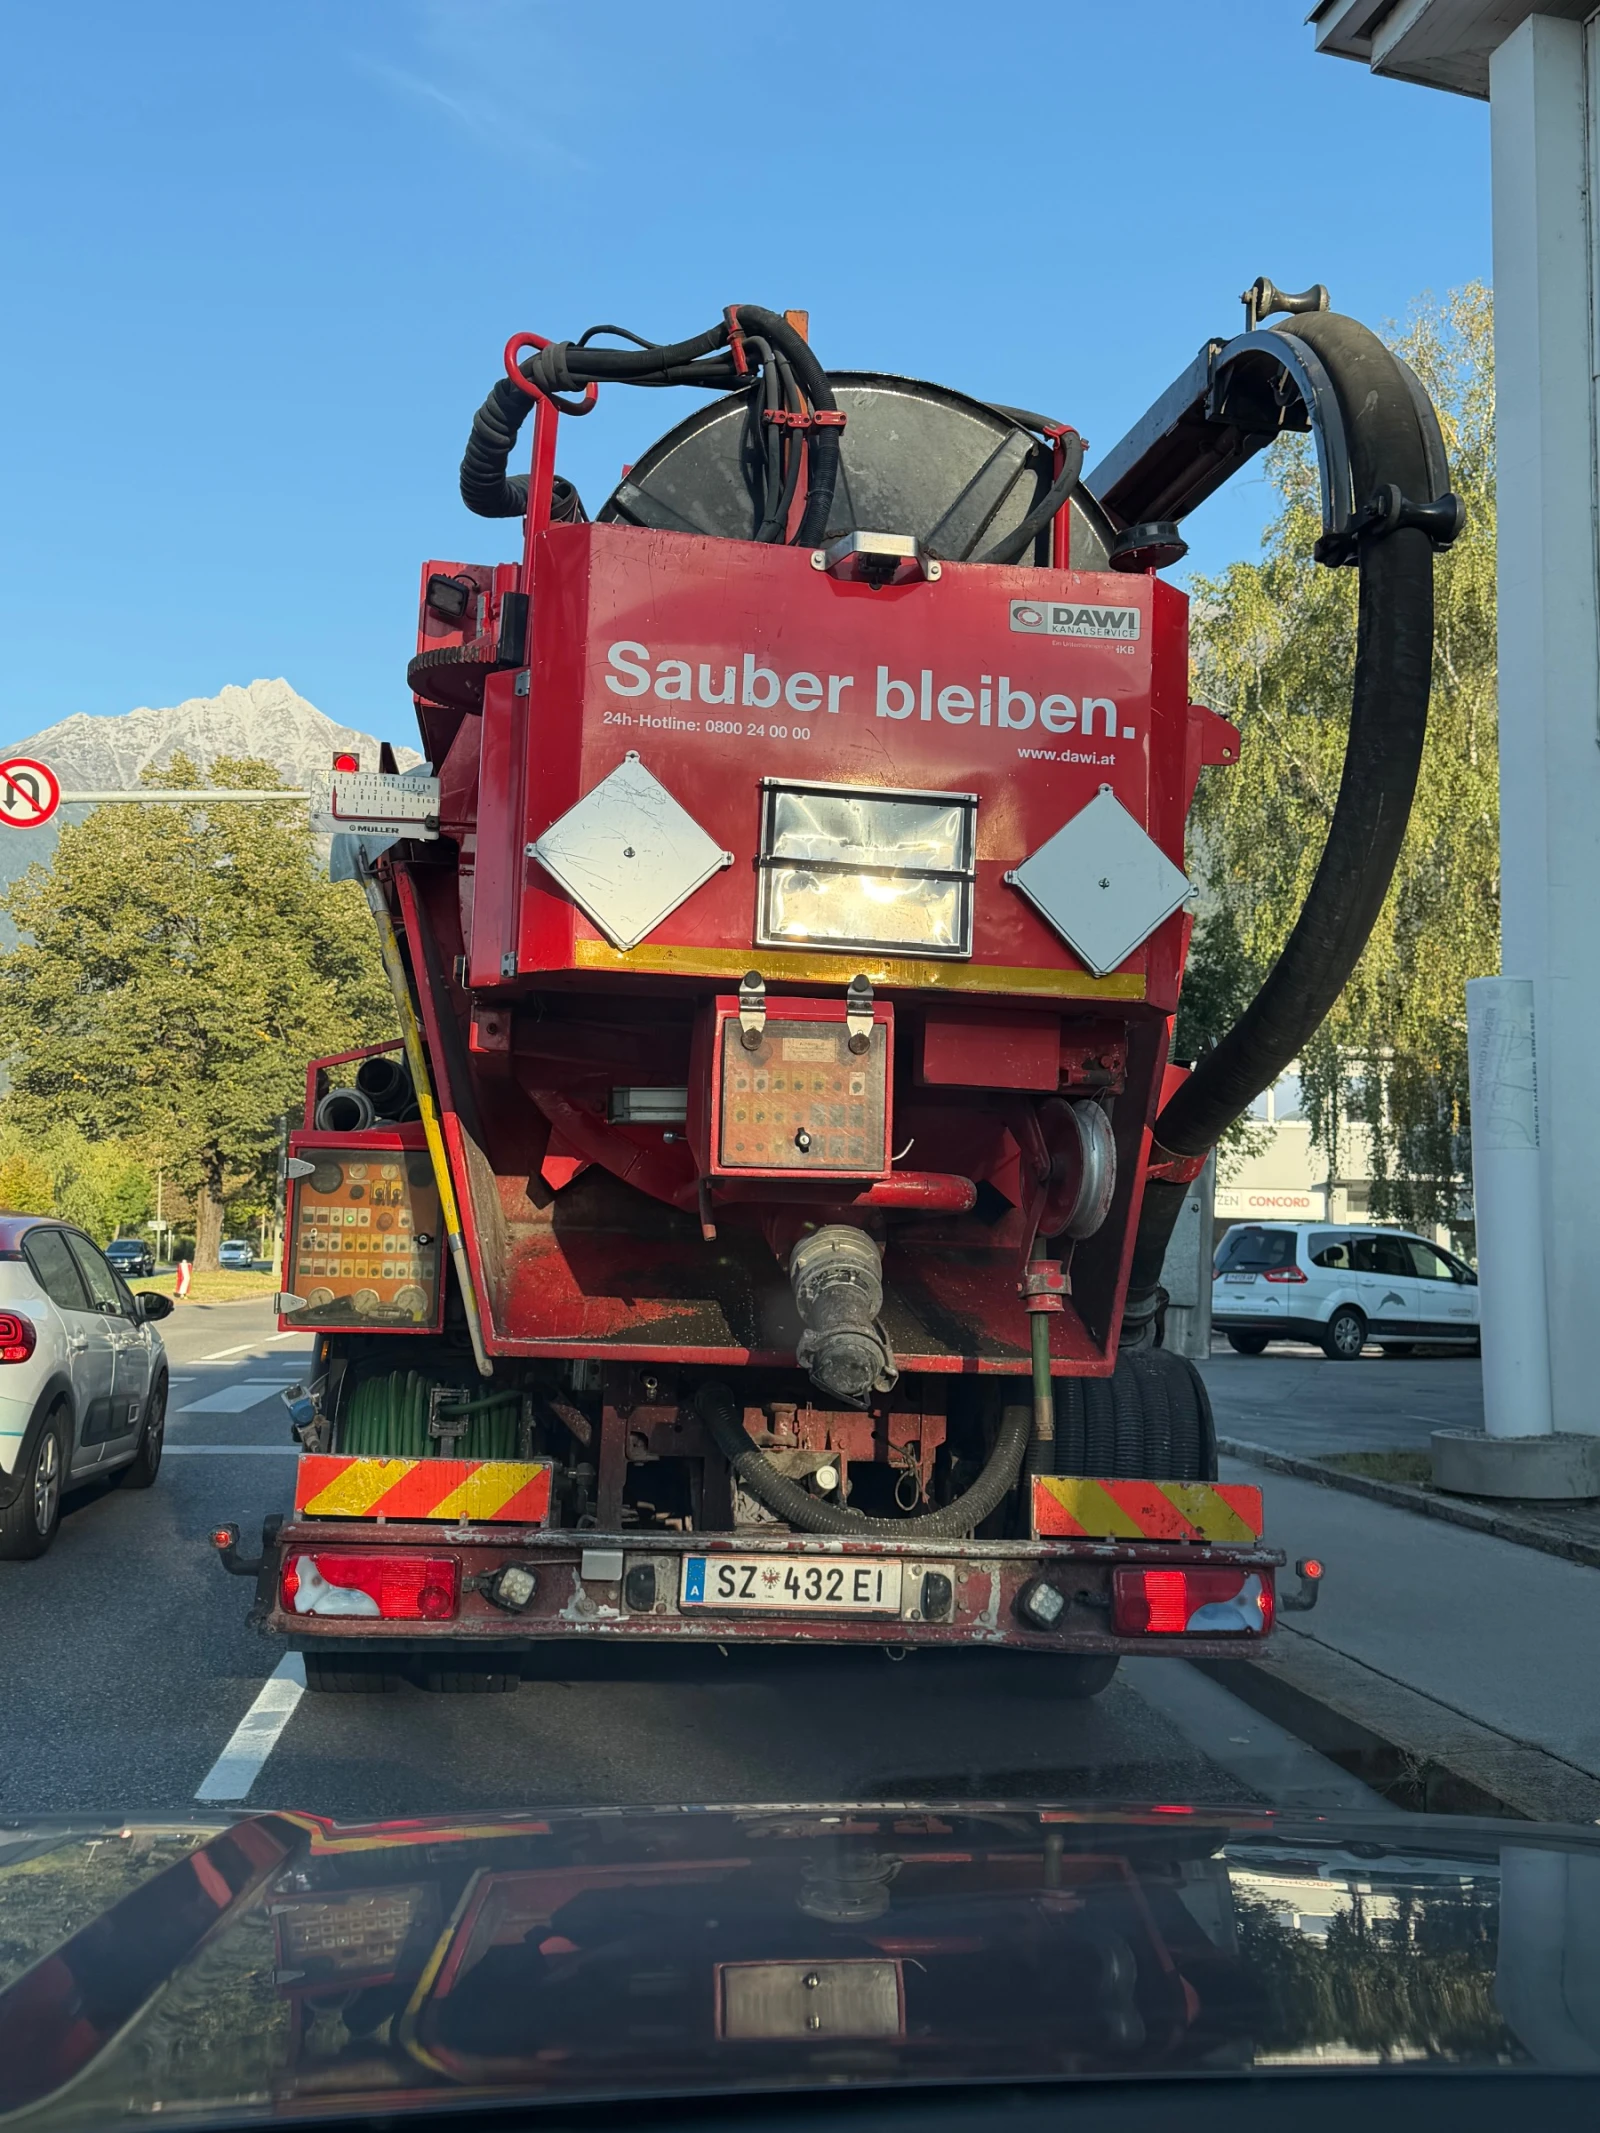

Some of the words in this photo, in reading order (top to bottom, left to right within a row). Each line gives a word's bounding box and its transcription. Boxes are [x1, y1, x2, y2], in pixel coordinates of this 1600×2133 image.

[1053, 607, 1135, 629] DAWI
[1052, 625, 1135, 638] KANALSERVICE
[604, 640, 855, 714] Sauber
[875, 665, 1137, 740] bleiben.
[603, 711, 700, 732] 24h-Hotline:
[705, 719, 743, 735] 0800
[747, 723, 765, 737] 24
[769, 725, 788, 739] 00
[792, 727, 811, 741] 00
[1017, 748, 1116, 766] www.dawi.at
[1480, 1007, 1497, 1049] HAUSER
[1249, 1196, 1310, 1207] CONCORD
[690, 1585, 700, 1596] A
[717, 1564, 758, 1599] SZ
[784, 1566, 844, 1602] 432
[853, 1569, 883, 1603] EI
